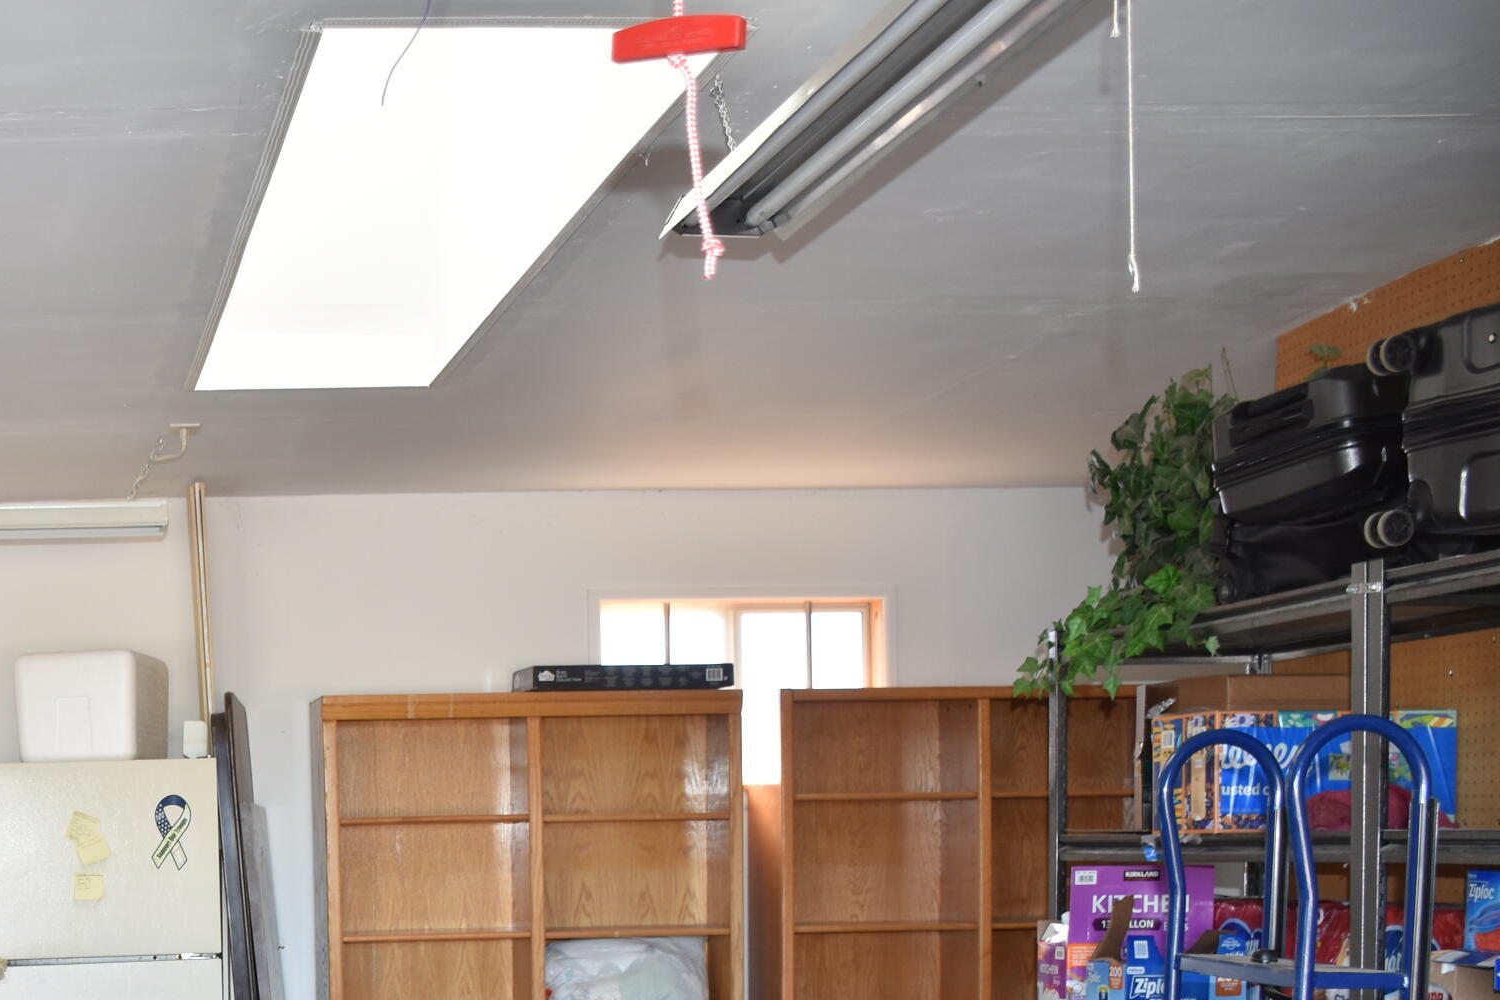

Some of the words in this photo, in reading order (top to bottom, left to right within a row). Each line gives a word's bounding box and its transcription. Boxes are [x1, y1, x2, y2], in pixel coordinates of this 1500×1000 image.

[1468, 883, 1495, 902] Ziploc
[1109, 966, 1123, 977] 200
[1133, 976, 1165, 998] Zipl
